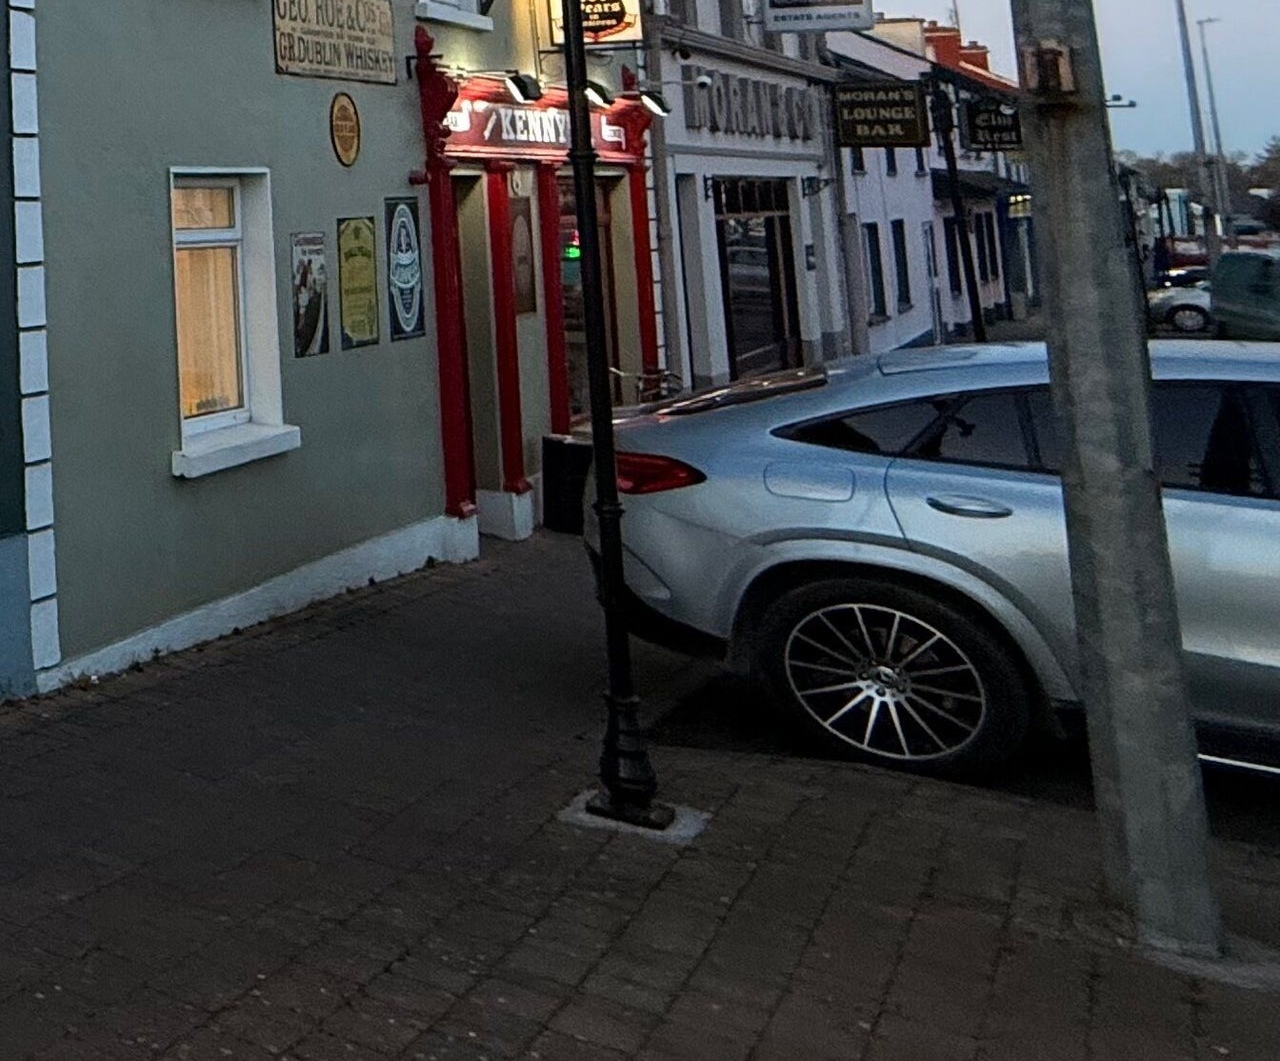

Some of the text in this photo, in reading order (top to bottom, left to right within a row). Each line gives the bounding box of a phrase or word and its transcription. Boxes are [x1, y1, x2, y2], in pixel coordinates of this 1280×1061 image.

[297, 36, 342, 68] DUBLIN
[344, 42, 394, 75] WHISKEY
[838, 89, 915, 102] MORAN'S
[842, 106, 916, 120] LOUNGE
[855, 123, 906, 137] BAR
